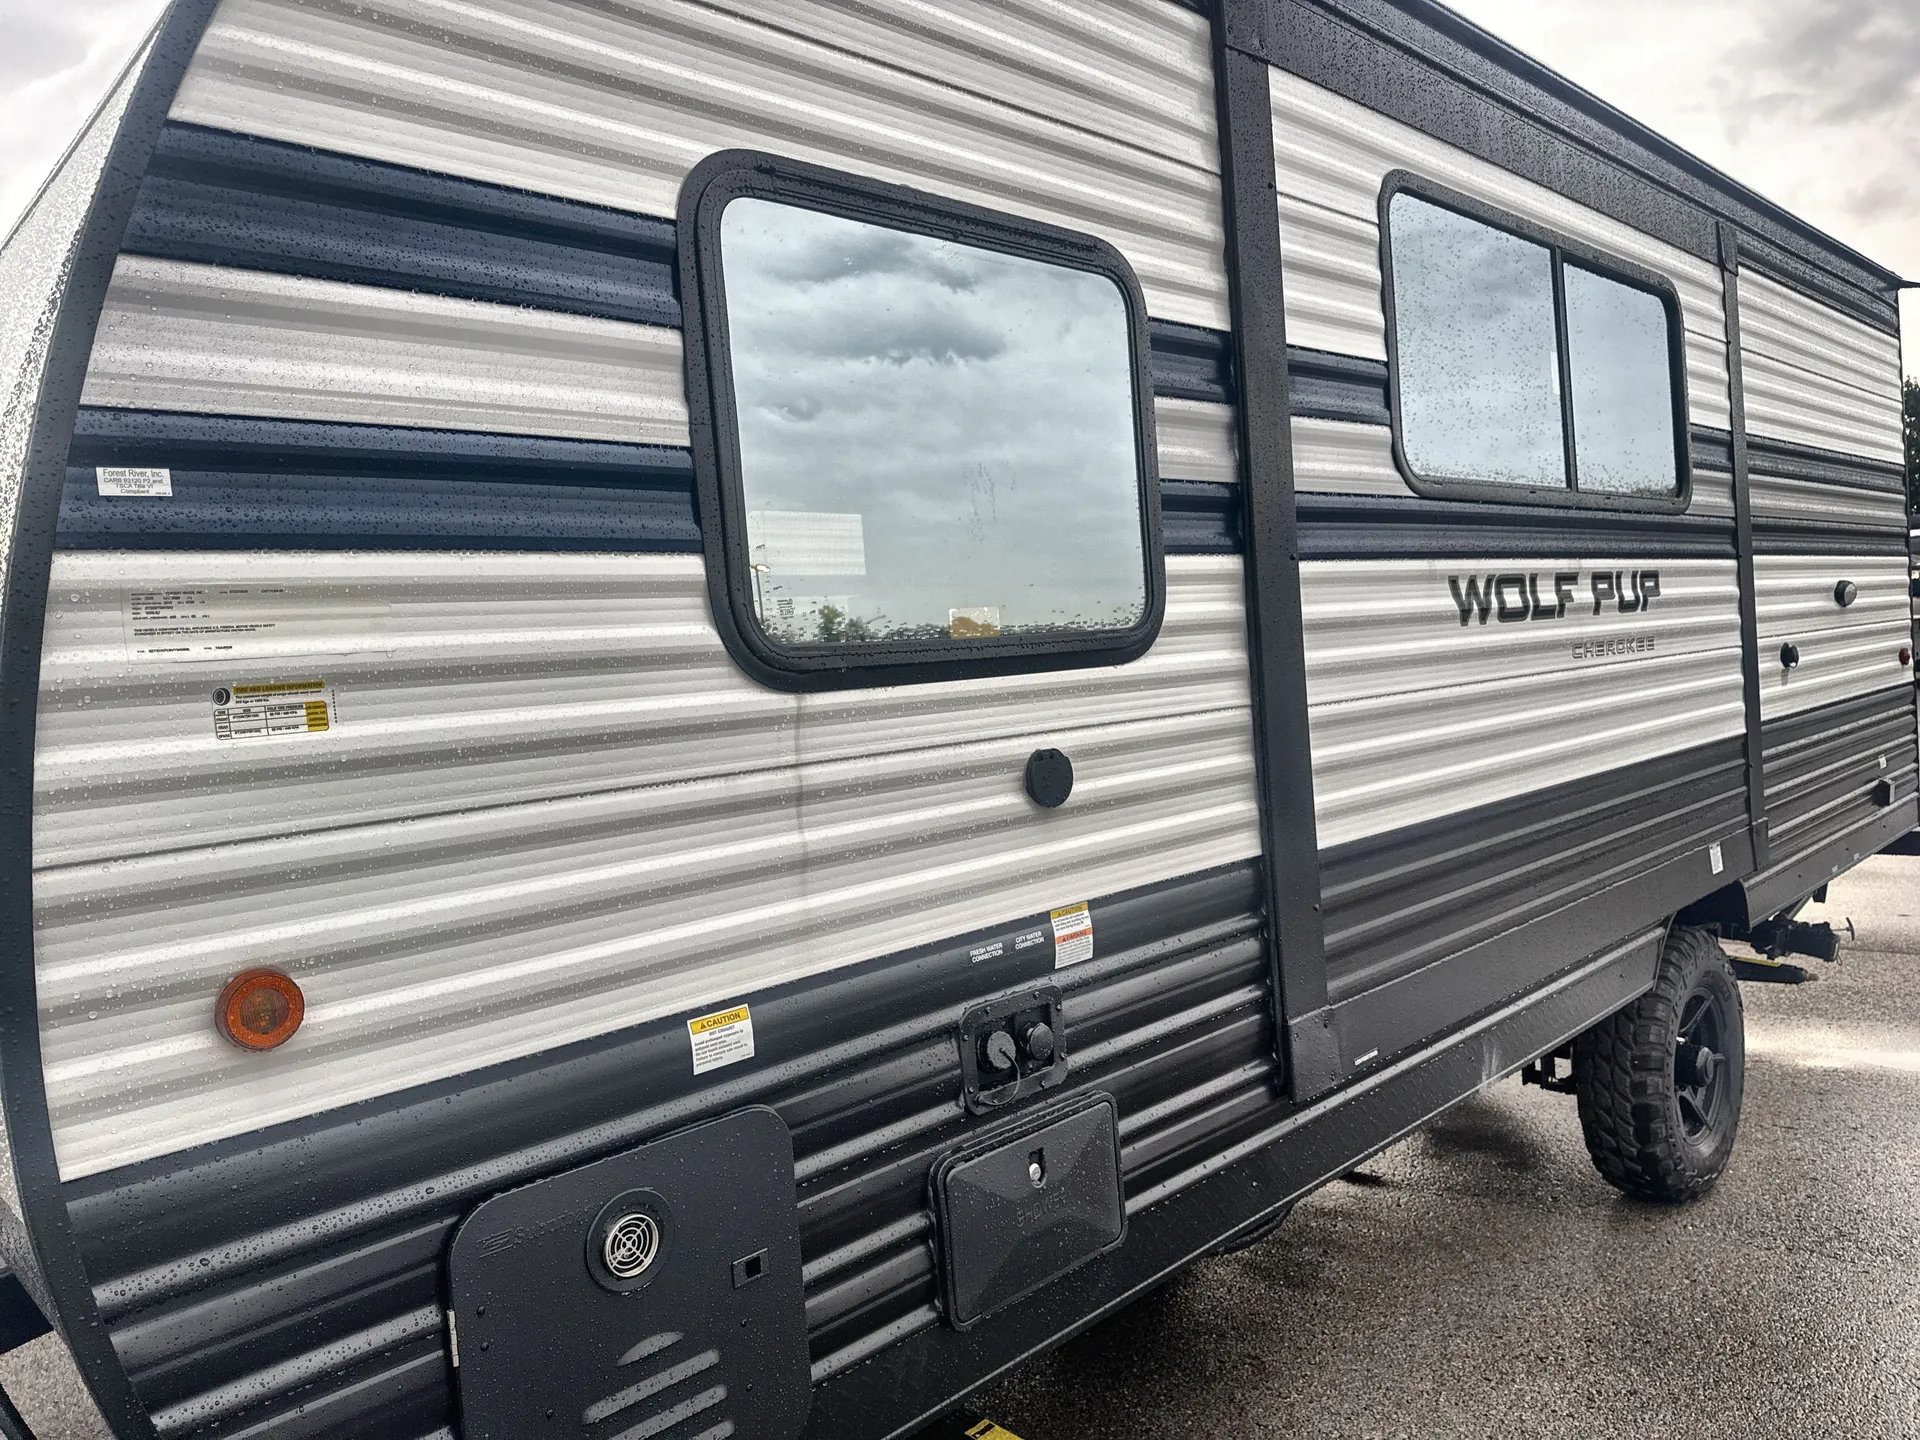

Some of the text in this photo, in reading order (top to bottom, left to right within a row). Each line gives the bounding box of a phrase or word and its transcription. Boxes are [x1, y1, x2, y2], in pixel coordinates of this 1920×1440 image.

[103, 469, 126, 477] Forest
[128, 470, 149, 478] River,
[1448, 570, 1661, 627] WOLF PUP
[1572, 636, 1655, 660] CHEROKEE
[1015, 930, 1042, 943] CITY WATER
[1015, 937, 1045, 950] CONNECTION
[970, 942, 1003, 957] FRESH WATER
[972, 949, 1003, 963] CONNECTION
[706, 1012, 741, 1027] CAUTION
